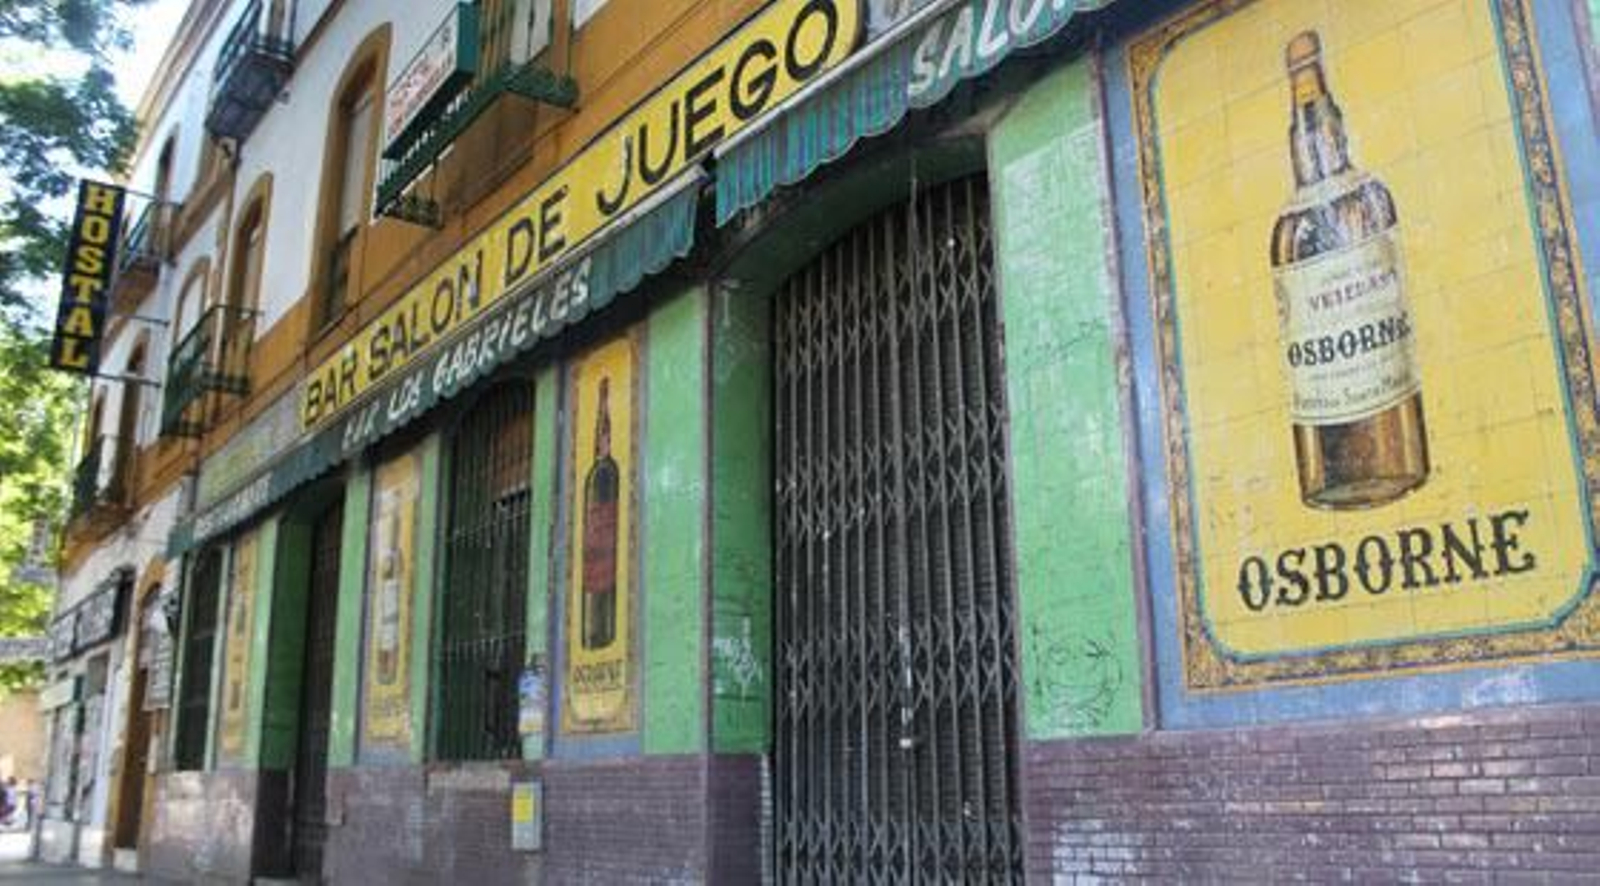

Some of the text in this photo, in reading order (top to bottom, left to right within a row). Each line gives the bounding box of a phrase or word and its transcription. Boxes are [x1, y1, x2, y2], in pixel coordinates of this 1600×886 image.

[907, 0, 1068, 97] SALO
[304, 348, 357, 428] BAR
[367, 250, 482, 380] SALON
[504, 184, 568, 286] DE
[596, 0, 838, 217] JUEGO
[60, 182, 119, 367] HOSTAL
[432, 256, 592, 393] GABRIELES
[1287, 311, 1411, 368] OSBORNE
[1236, 509, 1536, 612] OSBORNE
